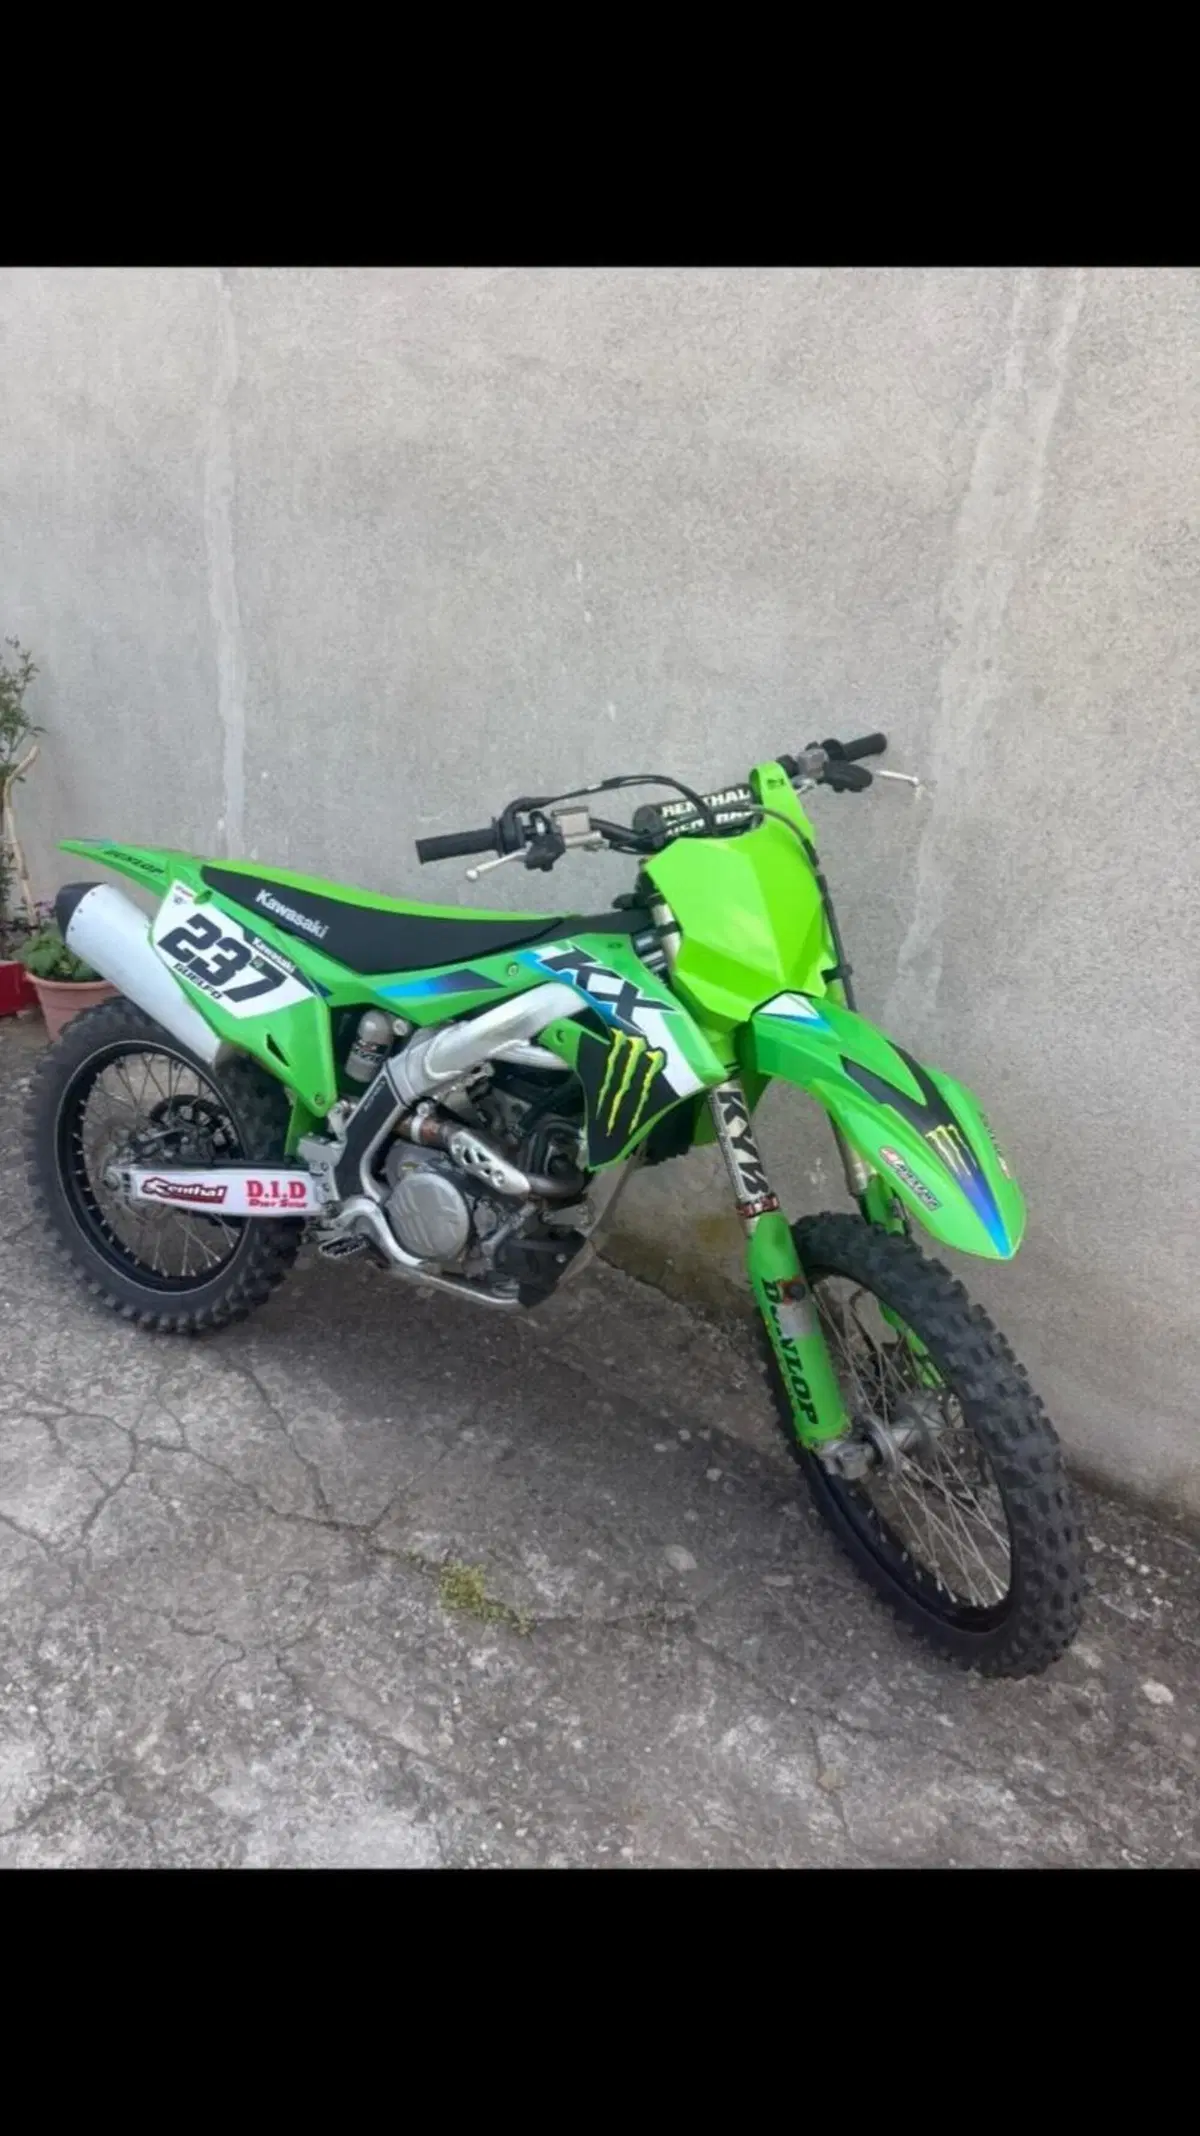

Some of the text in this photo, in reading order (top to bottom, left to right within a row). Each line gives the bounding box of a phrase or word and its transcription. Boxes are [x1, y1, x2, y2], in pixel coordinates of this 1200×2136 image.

[252, 936, 297, 974] Kawasaki
[255, 888, 330, 938] Kawasaki
[157, 913, 287, 1003] 237
[540, 946, 676, 1032] KX
[716, 1090, 771, 1195] KYB
[246, 1180, 307, 1199] D.I.D
[761, 1277, 819, 1425] DNLOP
